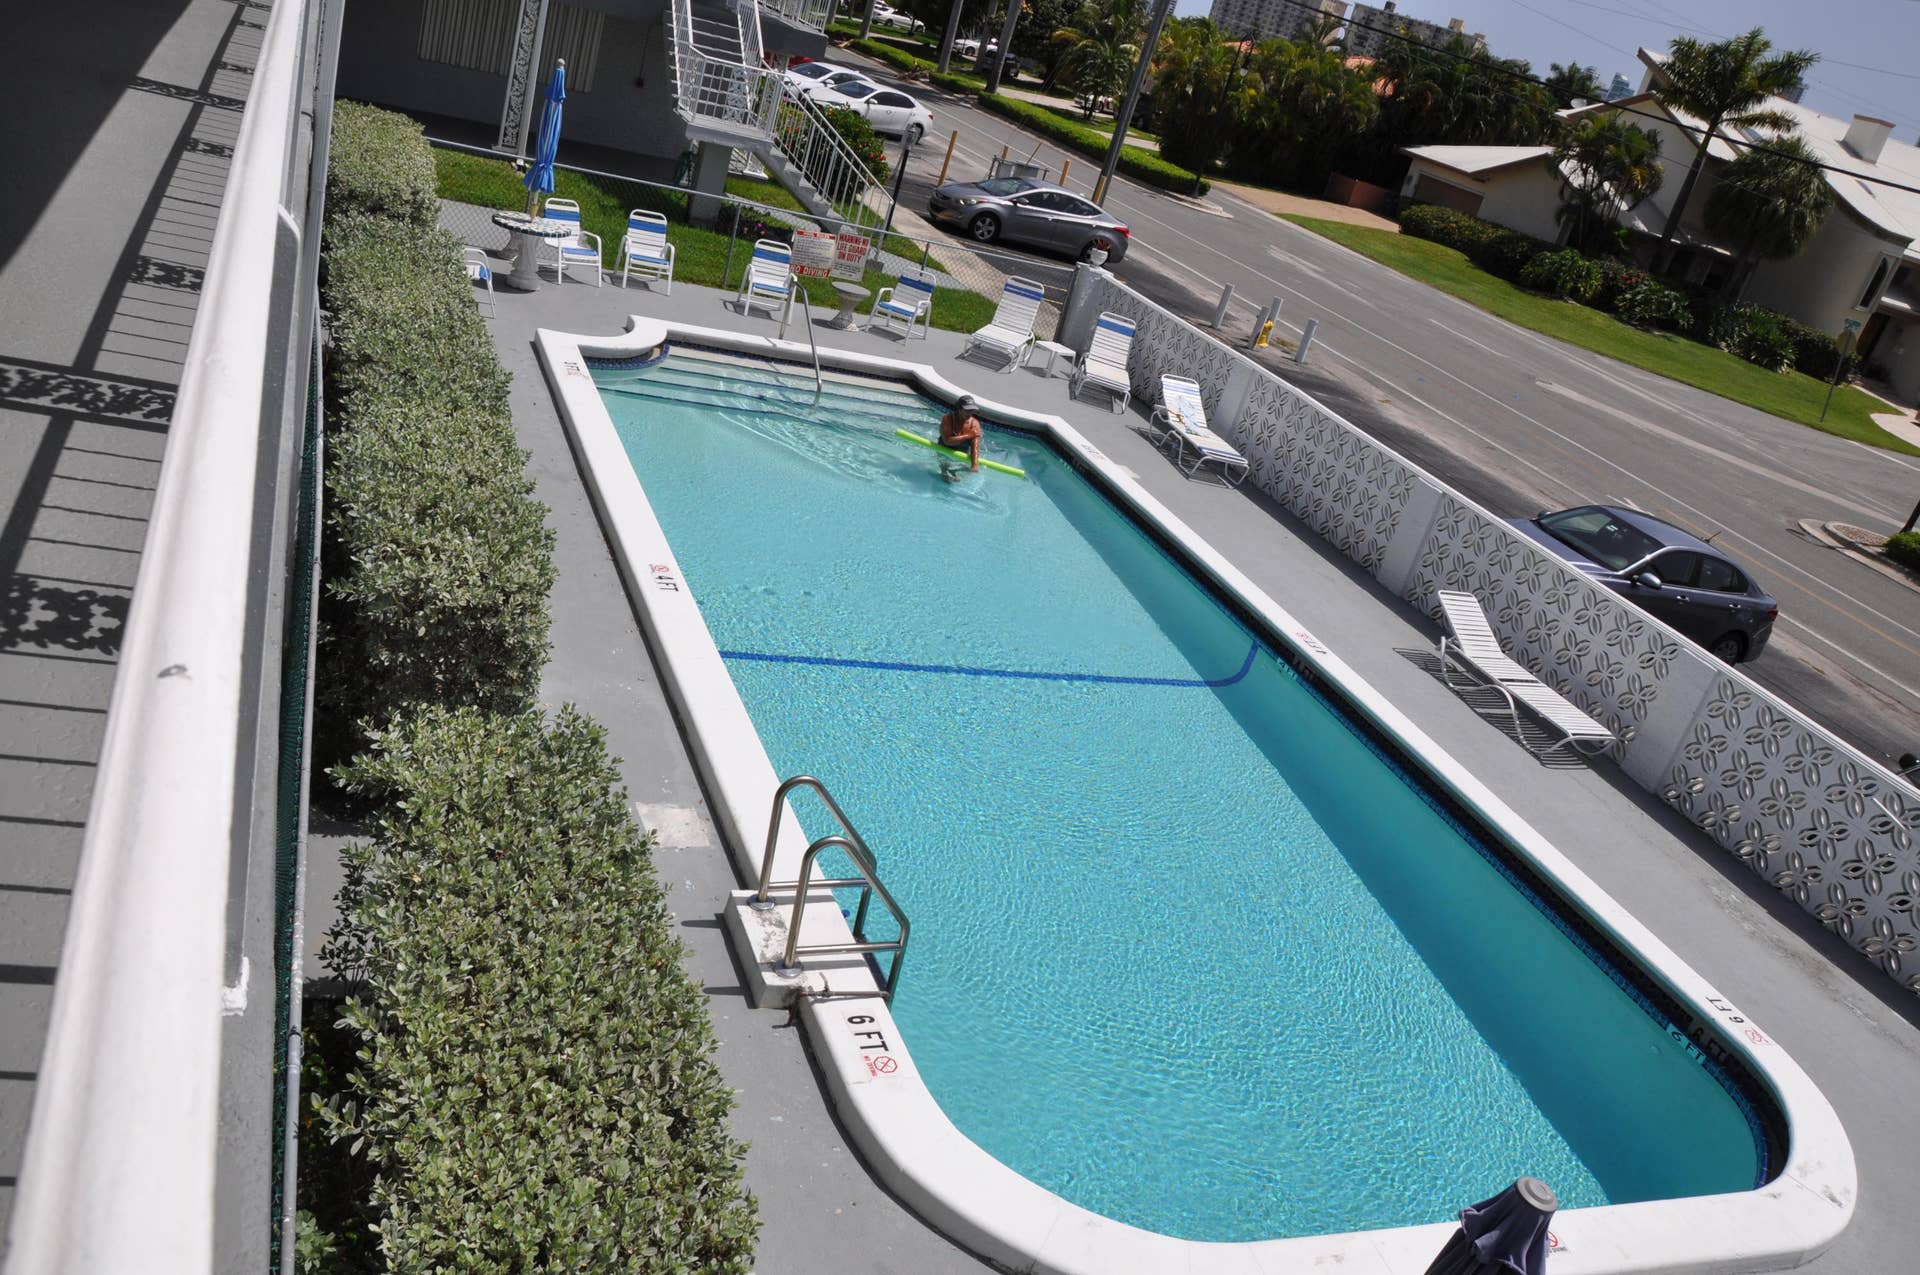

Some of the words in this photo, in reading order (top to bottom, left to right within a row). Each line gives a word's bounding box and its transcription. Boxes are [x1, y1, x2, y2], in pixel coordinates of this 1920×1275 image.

[790, 264, 801, 273] NO
[803, 266, 828, 277] DIVING
[847, 1015, 876, 1025] 6
[1728, 1016, 1745, 1024] 6
[854, 1030, 890, 1052] FT
[1671, 1031, 1683, 1042] 6
[1685, 1042, 1704, 1060] FT
